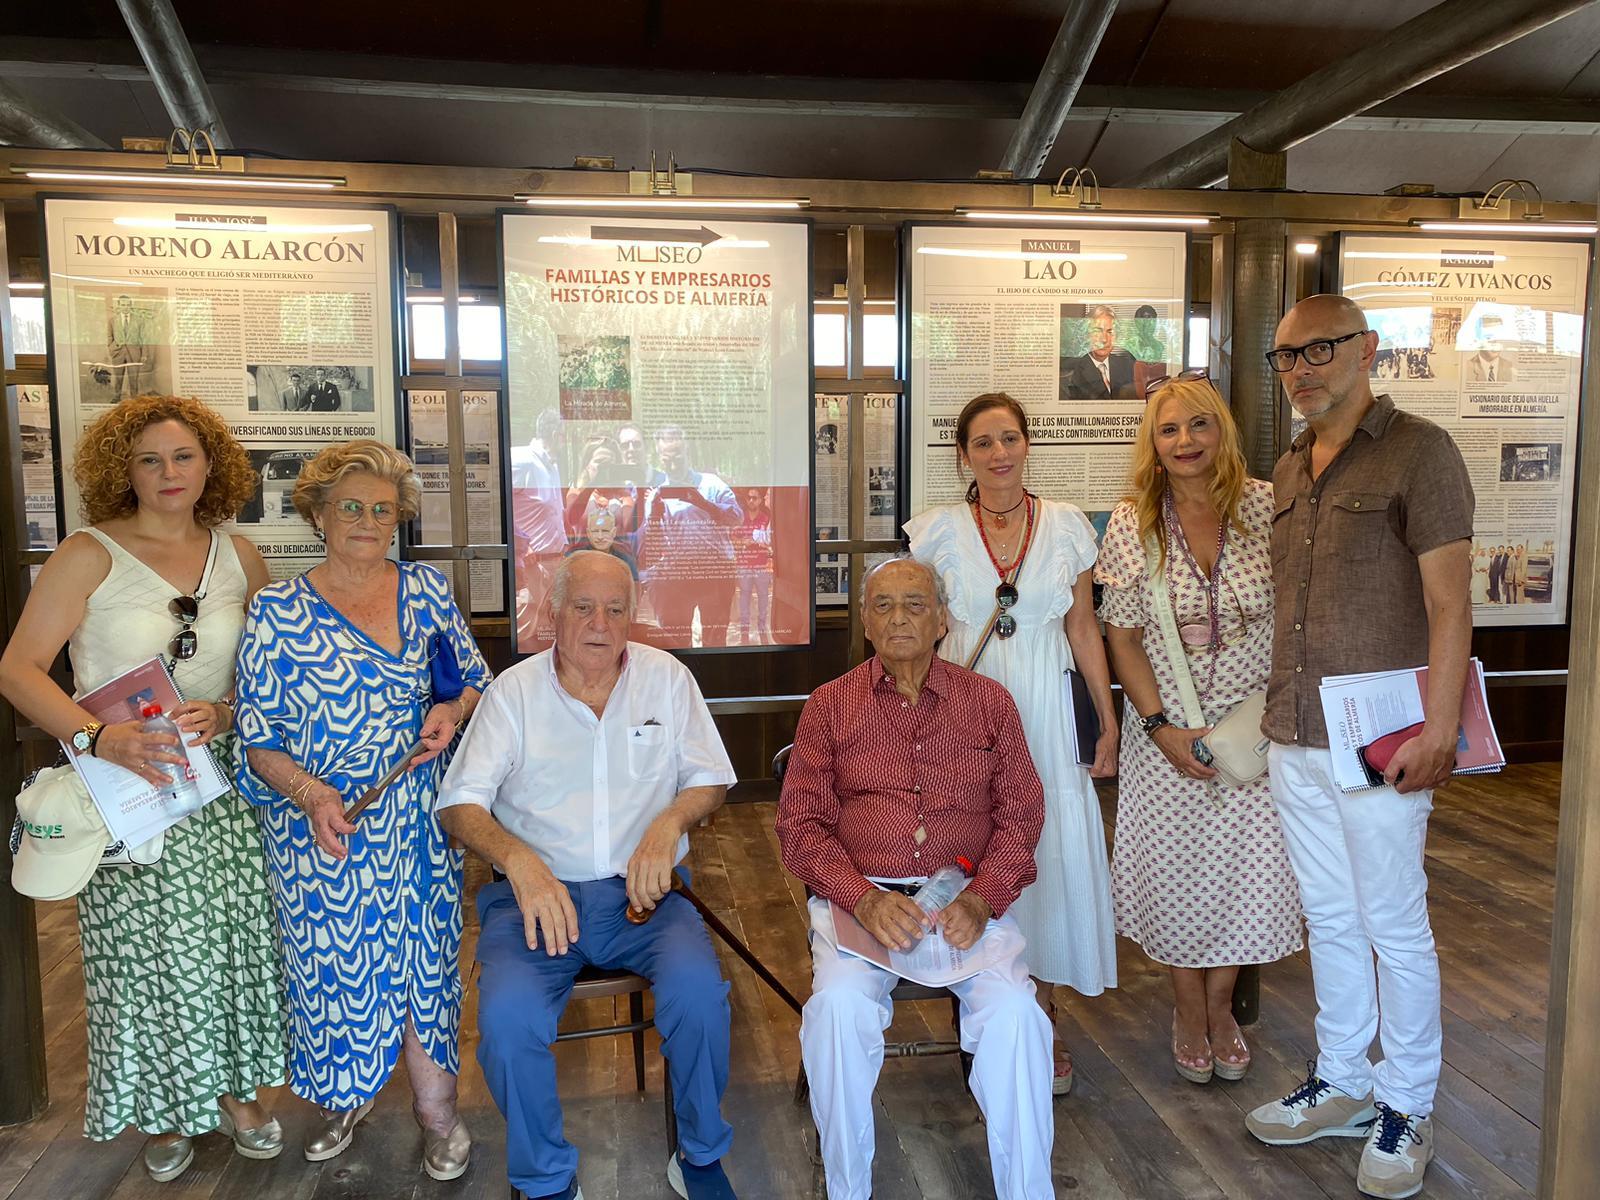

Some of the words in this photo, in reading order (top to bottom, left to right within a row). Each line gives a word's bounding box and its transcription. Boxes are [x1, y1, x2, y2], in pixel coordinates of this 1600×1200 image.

[75, 234, 212, 259] MORENO
[220, 236, 366, 262] ALARCÓN
[1028, 241, 1073, 251] MANUEL
[189, 270, 206, 278] QUE
[207, 270, 234, 278] ELIGIÓ
[1024, 260, 1077, 280] LAO
[545, 268, 630, 284] FAMILIAS
[634, 271, 645, 285] Y
[652, 271, 771, 288] EMPRESARIOS
[1377, 266, 1450, 289] GÓMEZ
[1455, 272, 1552, 291] VIVANCOS
[550, 285, 658, 304] HISTÓRICOS
[664, 290, 685, 305] DE
[691, 288, 768, 306] ALMERÍA
[1032, 286, 1061, 294] CÁNDIDO
[1469, 394, 1500, 403] VISIONARIO
[1500, 394, 1512, 403] QUE
[1512, 394, 1526, 403] DEJÓ
[1526, 395, 1537, 403] UNA
[1538, 395, 1559, 403] HUELLA
[1478, 404, 1513, 413] IMBORRABLE
[1514, 405, 1522, 413] EN
[932, 418, 959, 427] MANUE
[1032, 417, 1041, 426] DE
[1042, 417, 1055, 426] LOS
[1056, 416, 1121, 426] MULTIMILLONARIOS
[288, 426, 303, 436] SUS
[305, 424, 331, 436] LÍNEAS
[333, 426, 342, 436] DE
[344, 426, 376, 436] NEGOCIO
[939, 430, 949, 439] ES
[1065, 428, 1124, 438] CONTRIBUYENTES
[1125, 428, 1137, 438] DEL
[258, 544, 272, 554] POR
[273, 544, 282, 554] SU
[283, 543, 325, 554] DEDICACIÓN
